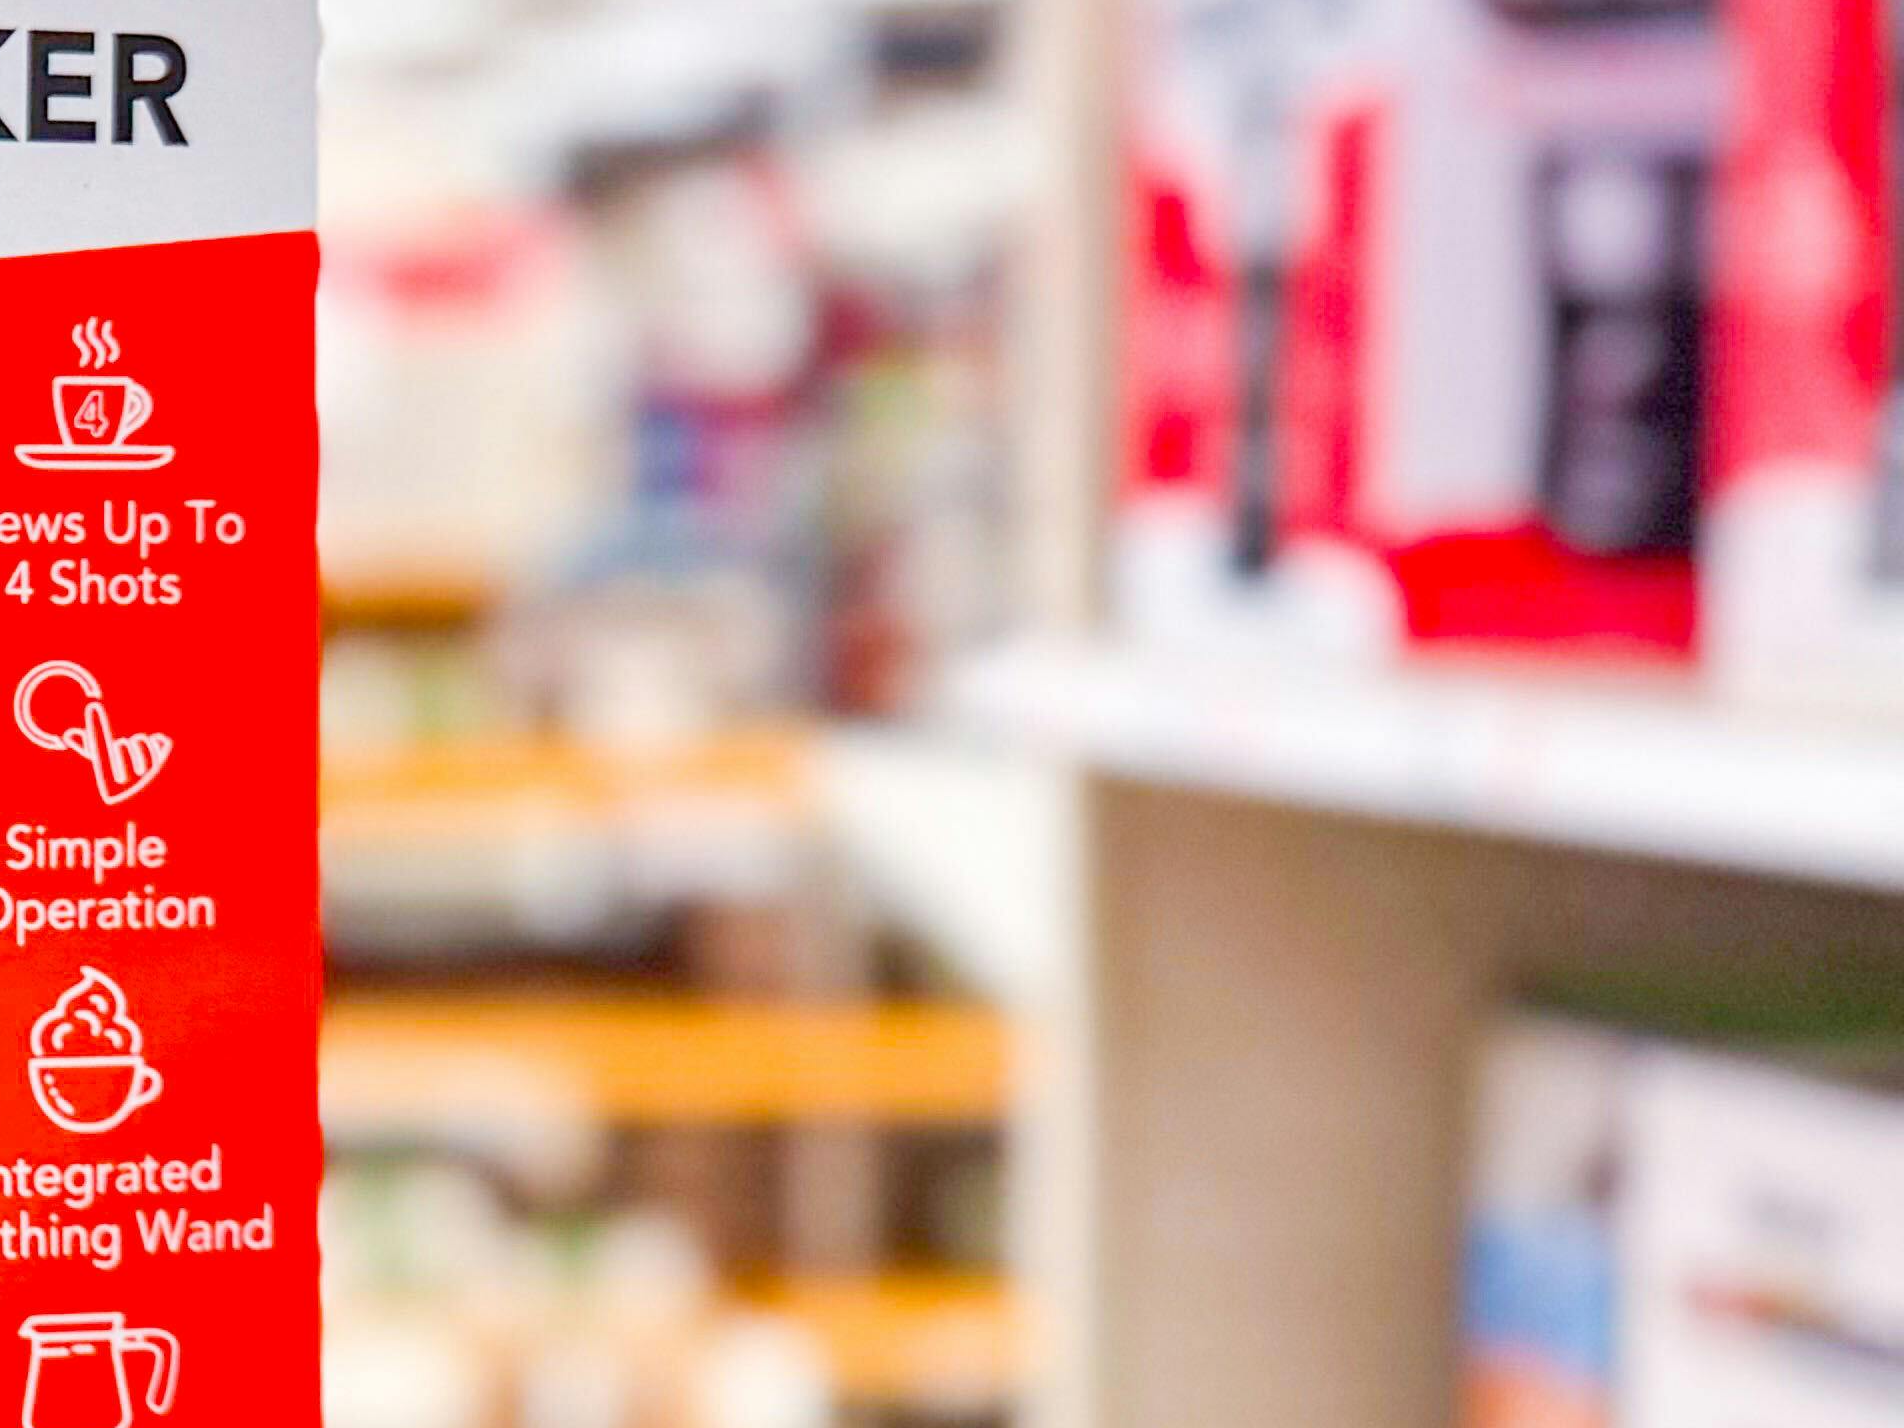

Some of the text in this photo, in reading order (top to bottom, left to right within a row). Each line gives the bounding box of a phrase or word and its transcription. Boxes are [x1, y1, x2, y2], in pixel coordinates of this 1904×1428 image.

[74, 390, 110, 436] 4
[103, 501, 170, 554] Up
[185, 500, 245, 545] To
[4, 558, 181, 606] 4 Shots
[5, 823, 167, 884] Simple
[135, 1205, 275, 1254] Wand
